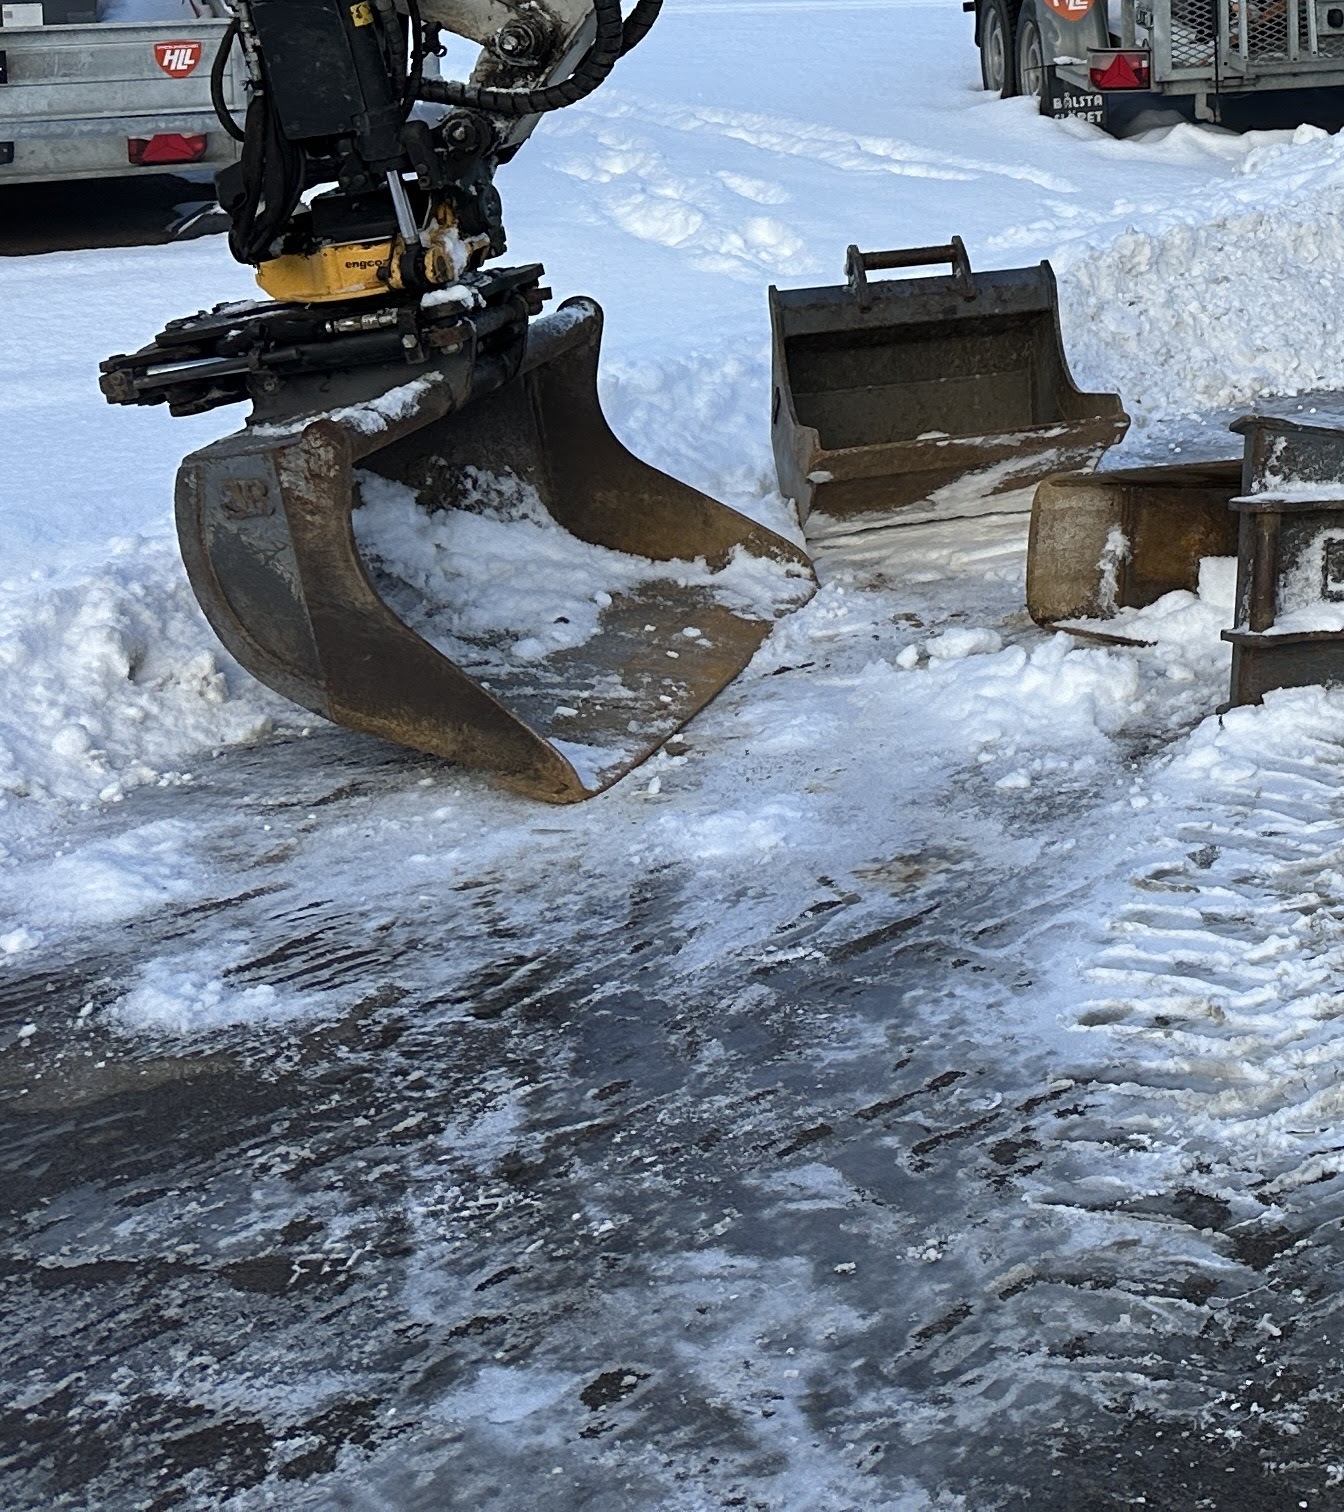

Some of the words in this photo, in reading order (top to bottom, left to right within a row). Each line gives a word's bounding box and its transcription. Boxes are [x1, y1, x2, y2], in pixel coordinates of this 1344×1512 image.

[162, 48, 195, 71] HLL
[1053, 92, 1103, 109] BÅLSTA
[345, 259, 386, 270] engco
